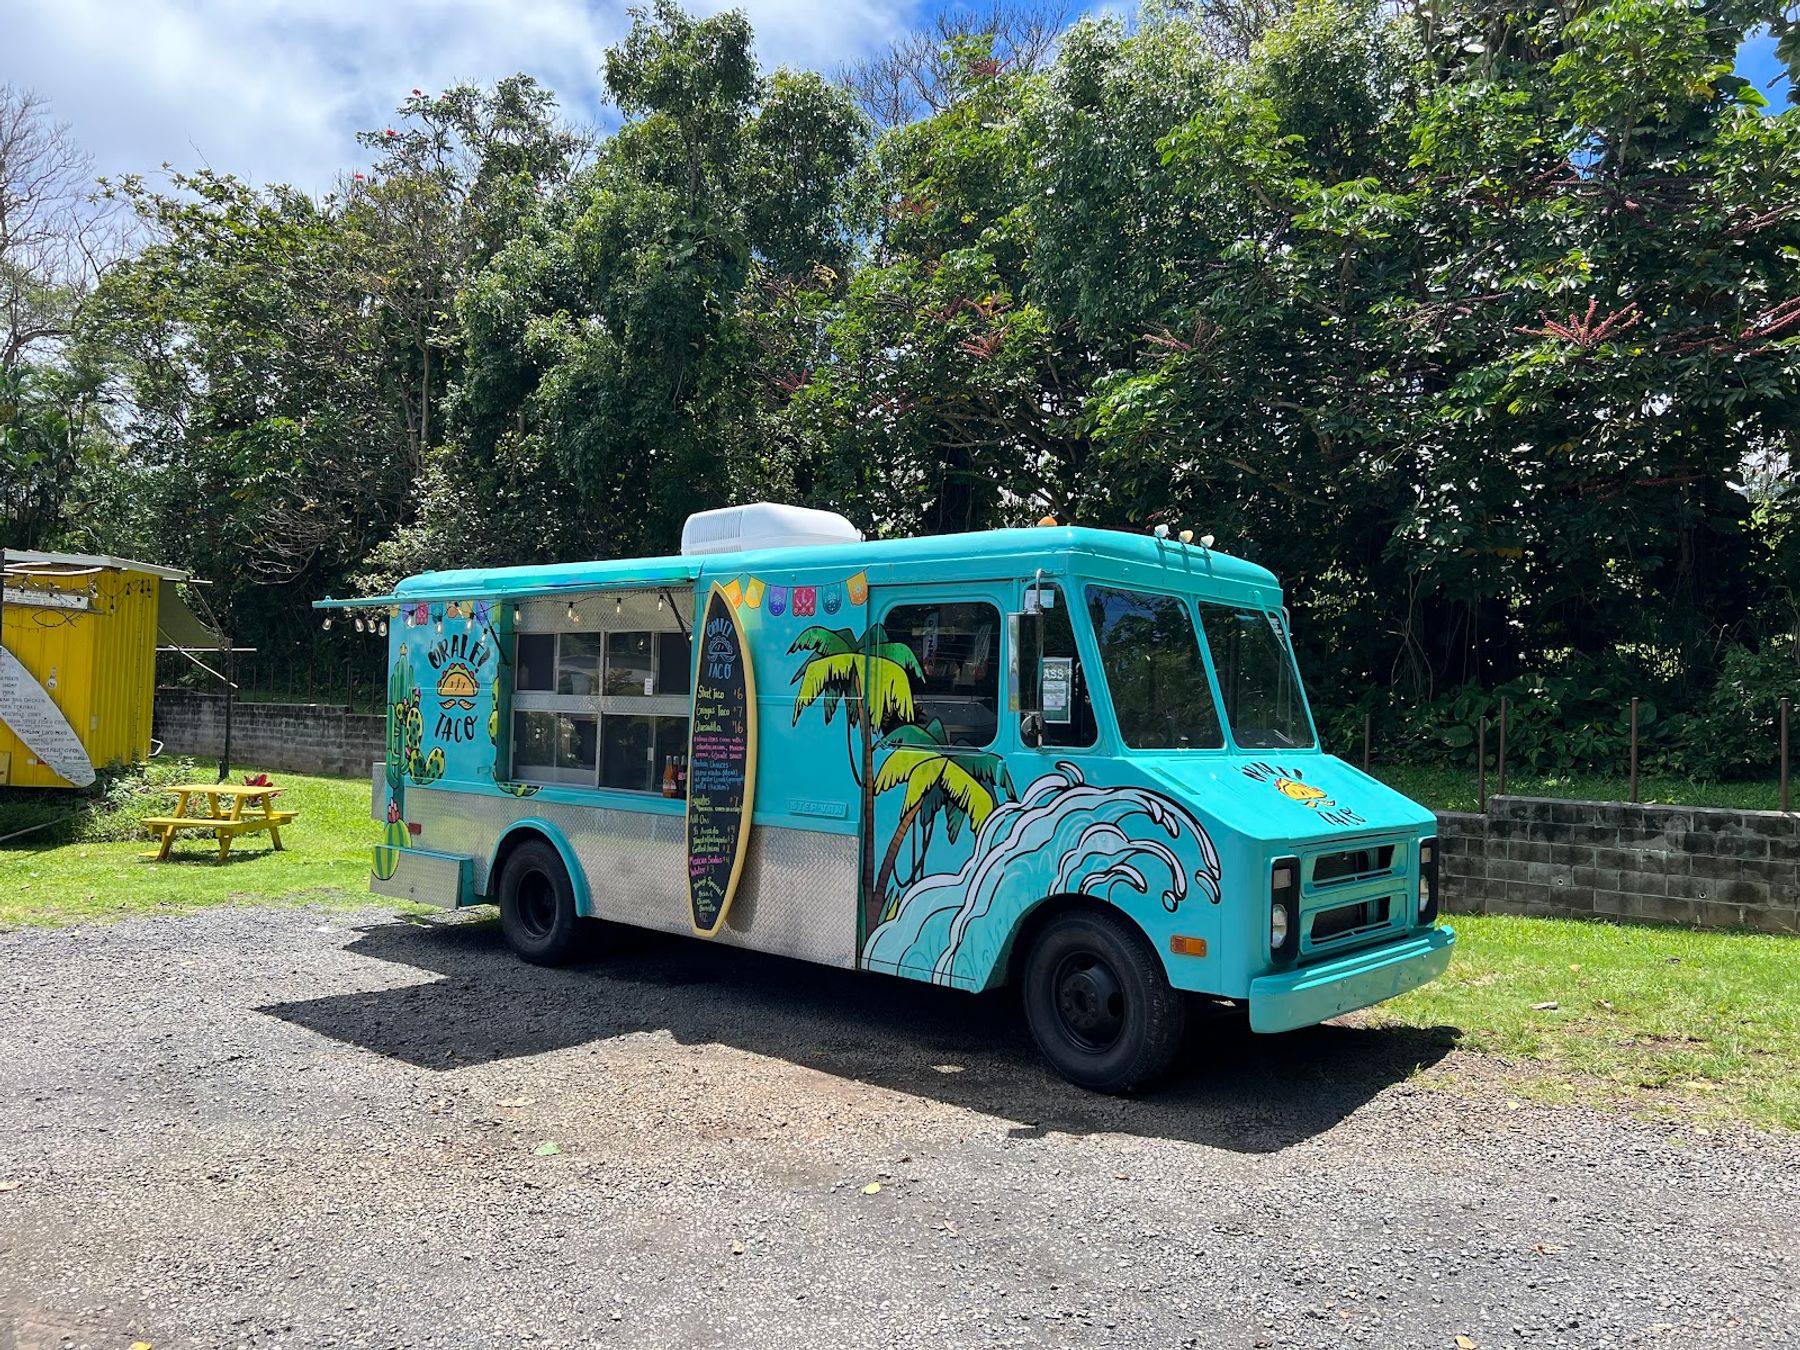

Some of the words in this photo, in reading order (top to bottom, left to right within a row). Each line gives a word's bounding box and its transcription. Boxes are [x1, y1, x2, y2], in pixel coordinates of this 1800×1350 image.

[708, 663, 733, 679] TACO
[1042, 669, 1064, 679] ASS
[712, 688, 725, 700] Taco
[717, 705, 730, 717] Taco
[434, 712, 478, 743] TACO
[1317, 807, 1366, 827] TACO
